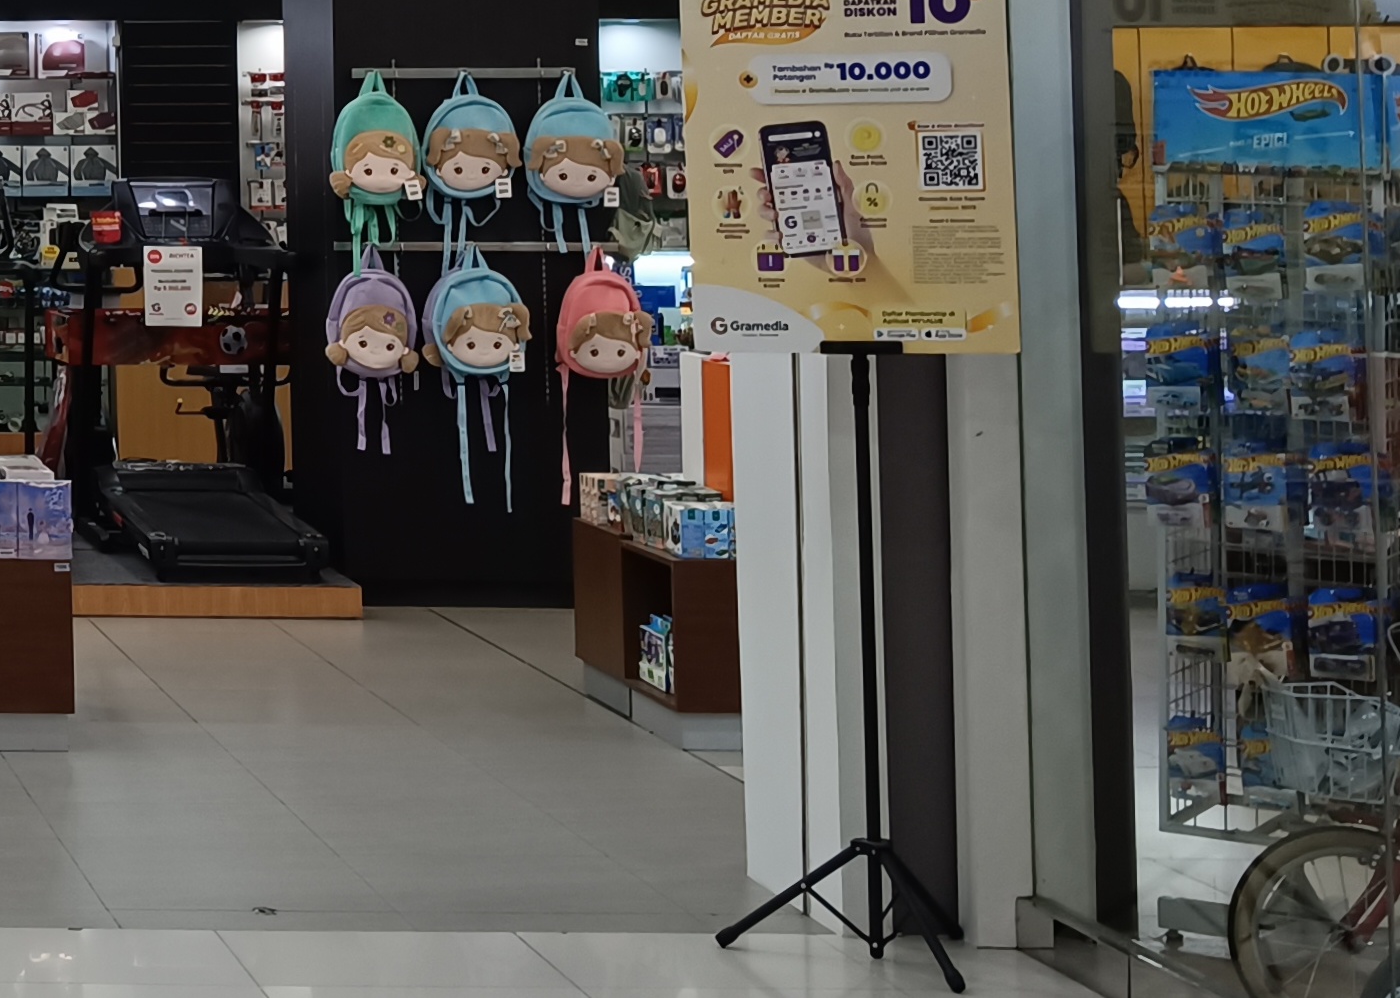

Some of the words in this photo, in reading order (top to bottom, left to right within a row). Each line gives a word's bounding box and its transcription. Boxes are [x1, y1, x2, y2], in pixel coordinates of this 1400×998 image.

[712, 5, 824, 35] MEMBER
[844, 7, 897, 18] DISKON
[836, 61, 931, 81] 10.000
[730, 320, 789, 332] Gramedia
